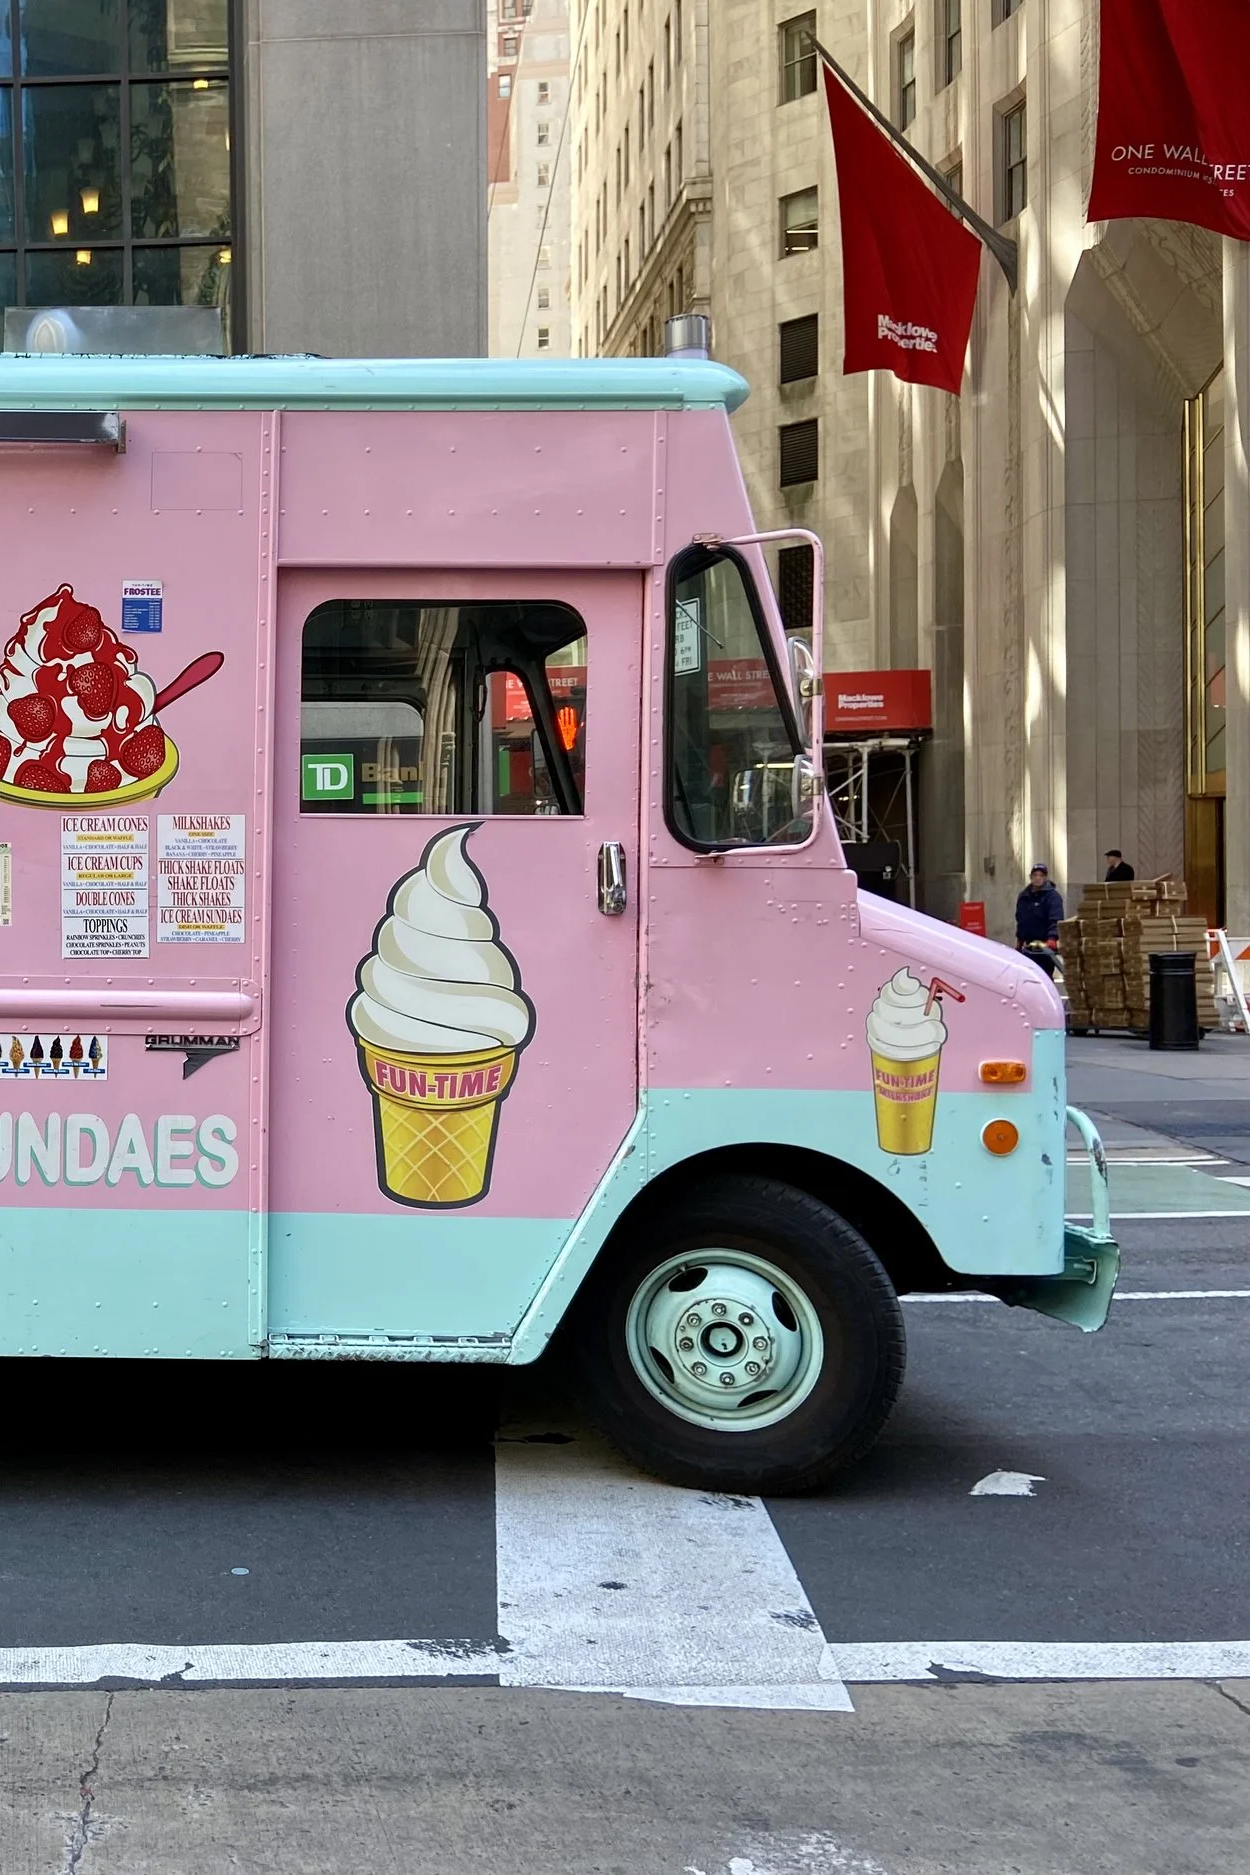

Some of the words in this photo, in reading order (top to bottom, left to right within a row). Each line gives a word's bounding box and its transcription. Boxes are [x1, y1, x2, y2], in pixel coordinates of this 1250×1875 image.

[1111, 144, 1155, 161] ONE
[1163, 144, 1208, 165] WALL
[1209, 164, 1250, 180] REE
[1128, 167, 1200, 179] CONDOMINIUM
[124, 588, 161, 596] FROSTEE
[717, 670, 742, 681] WALL
[745, 669, 771, 679] STRE
[308, 763, 348, 791] TD
[63, 817, 78, 832] ICE
[80, 817, 115, 832] CREAM
[117, 817, 148, 832] CONES
[173, 816, 231, 830] MILKSHAKES
[68, 856, 82, 870] ICE
[85, 856, 118, 870] CREAM
[120, 856, 143, 870] CUPS
[159, 860, 184, 875] THICK
[185, 860, 212, 875] SHAKE
[214, 860, 245, 875] FLOATS
[168, 876, 198, 891] SHAKE
[200, 876, 235, 891] FLOATS
[76, 892, 107, 906] DOUBLE
[109, 892, 135, 906] CONES
[171, 891, 198, 906] THICK
[199, 891, 231, 906] SHAKES
[160, 909, 174, 924] ICE
[175, 909, 205, 924] CREAM
[206, 909, 242, 924] SUNDAES
[83, 919, 128, 933] TOPPINGS
[145, 1035, 240, 1045] GRUMMAN
[374, 1059, 502, 1099] FUN-TIME
[876, 1068, 934, 1088] FUN-TIME
